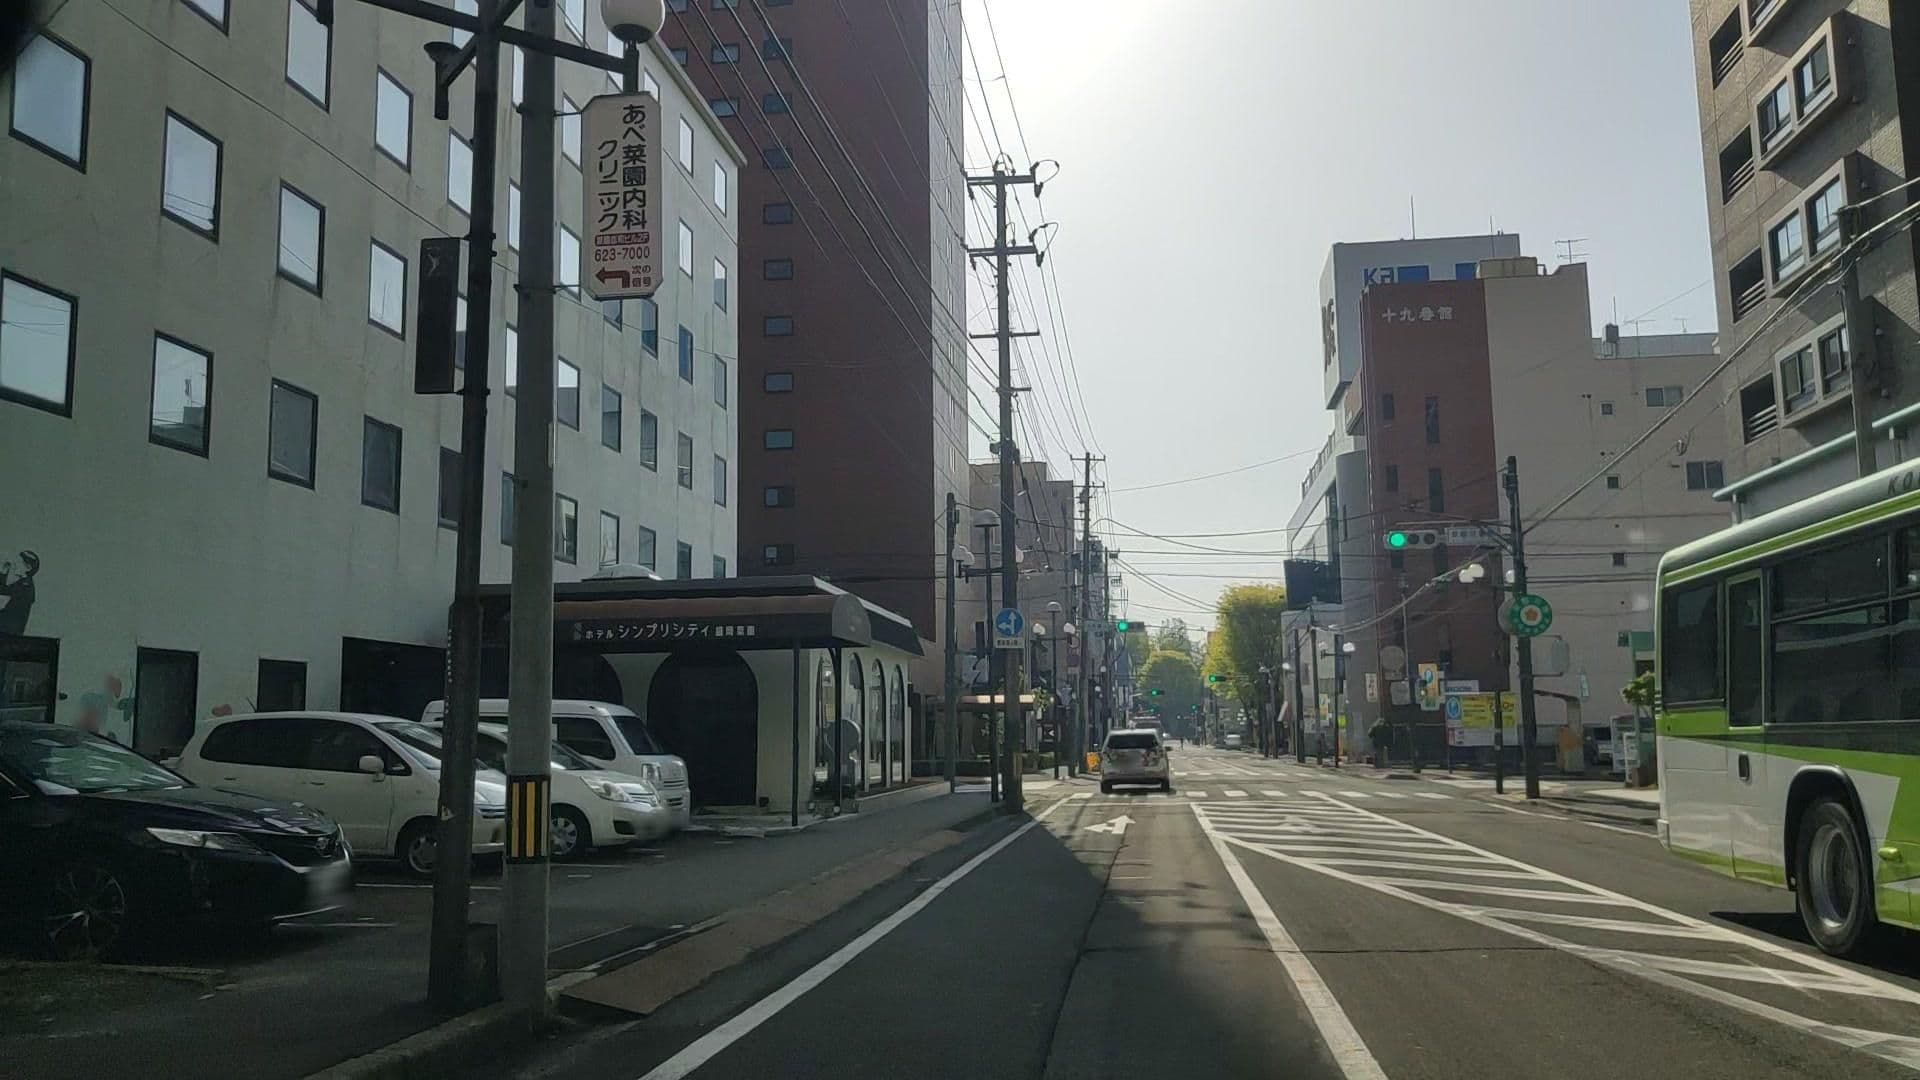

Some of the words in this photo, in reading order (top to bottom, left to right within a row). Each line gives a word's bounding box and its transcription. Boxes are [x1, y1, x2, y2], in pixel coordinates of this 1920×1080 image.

[598, 140, 619, 233] クリニック
[622, 104, 647, 230] あべ菜園内科
[595, 248, 650, 262] 623-7000
